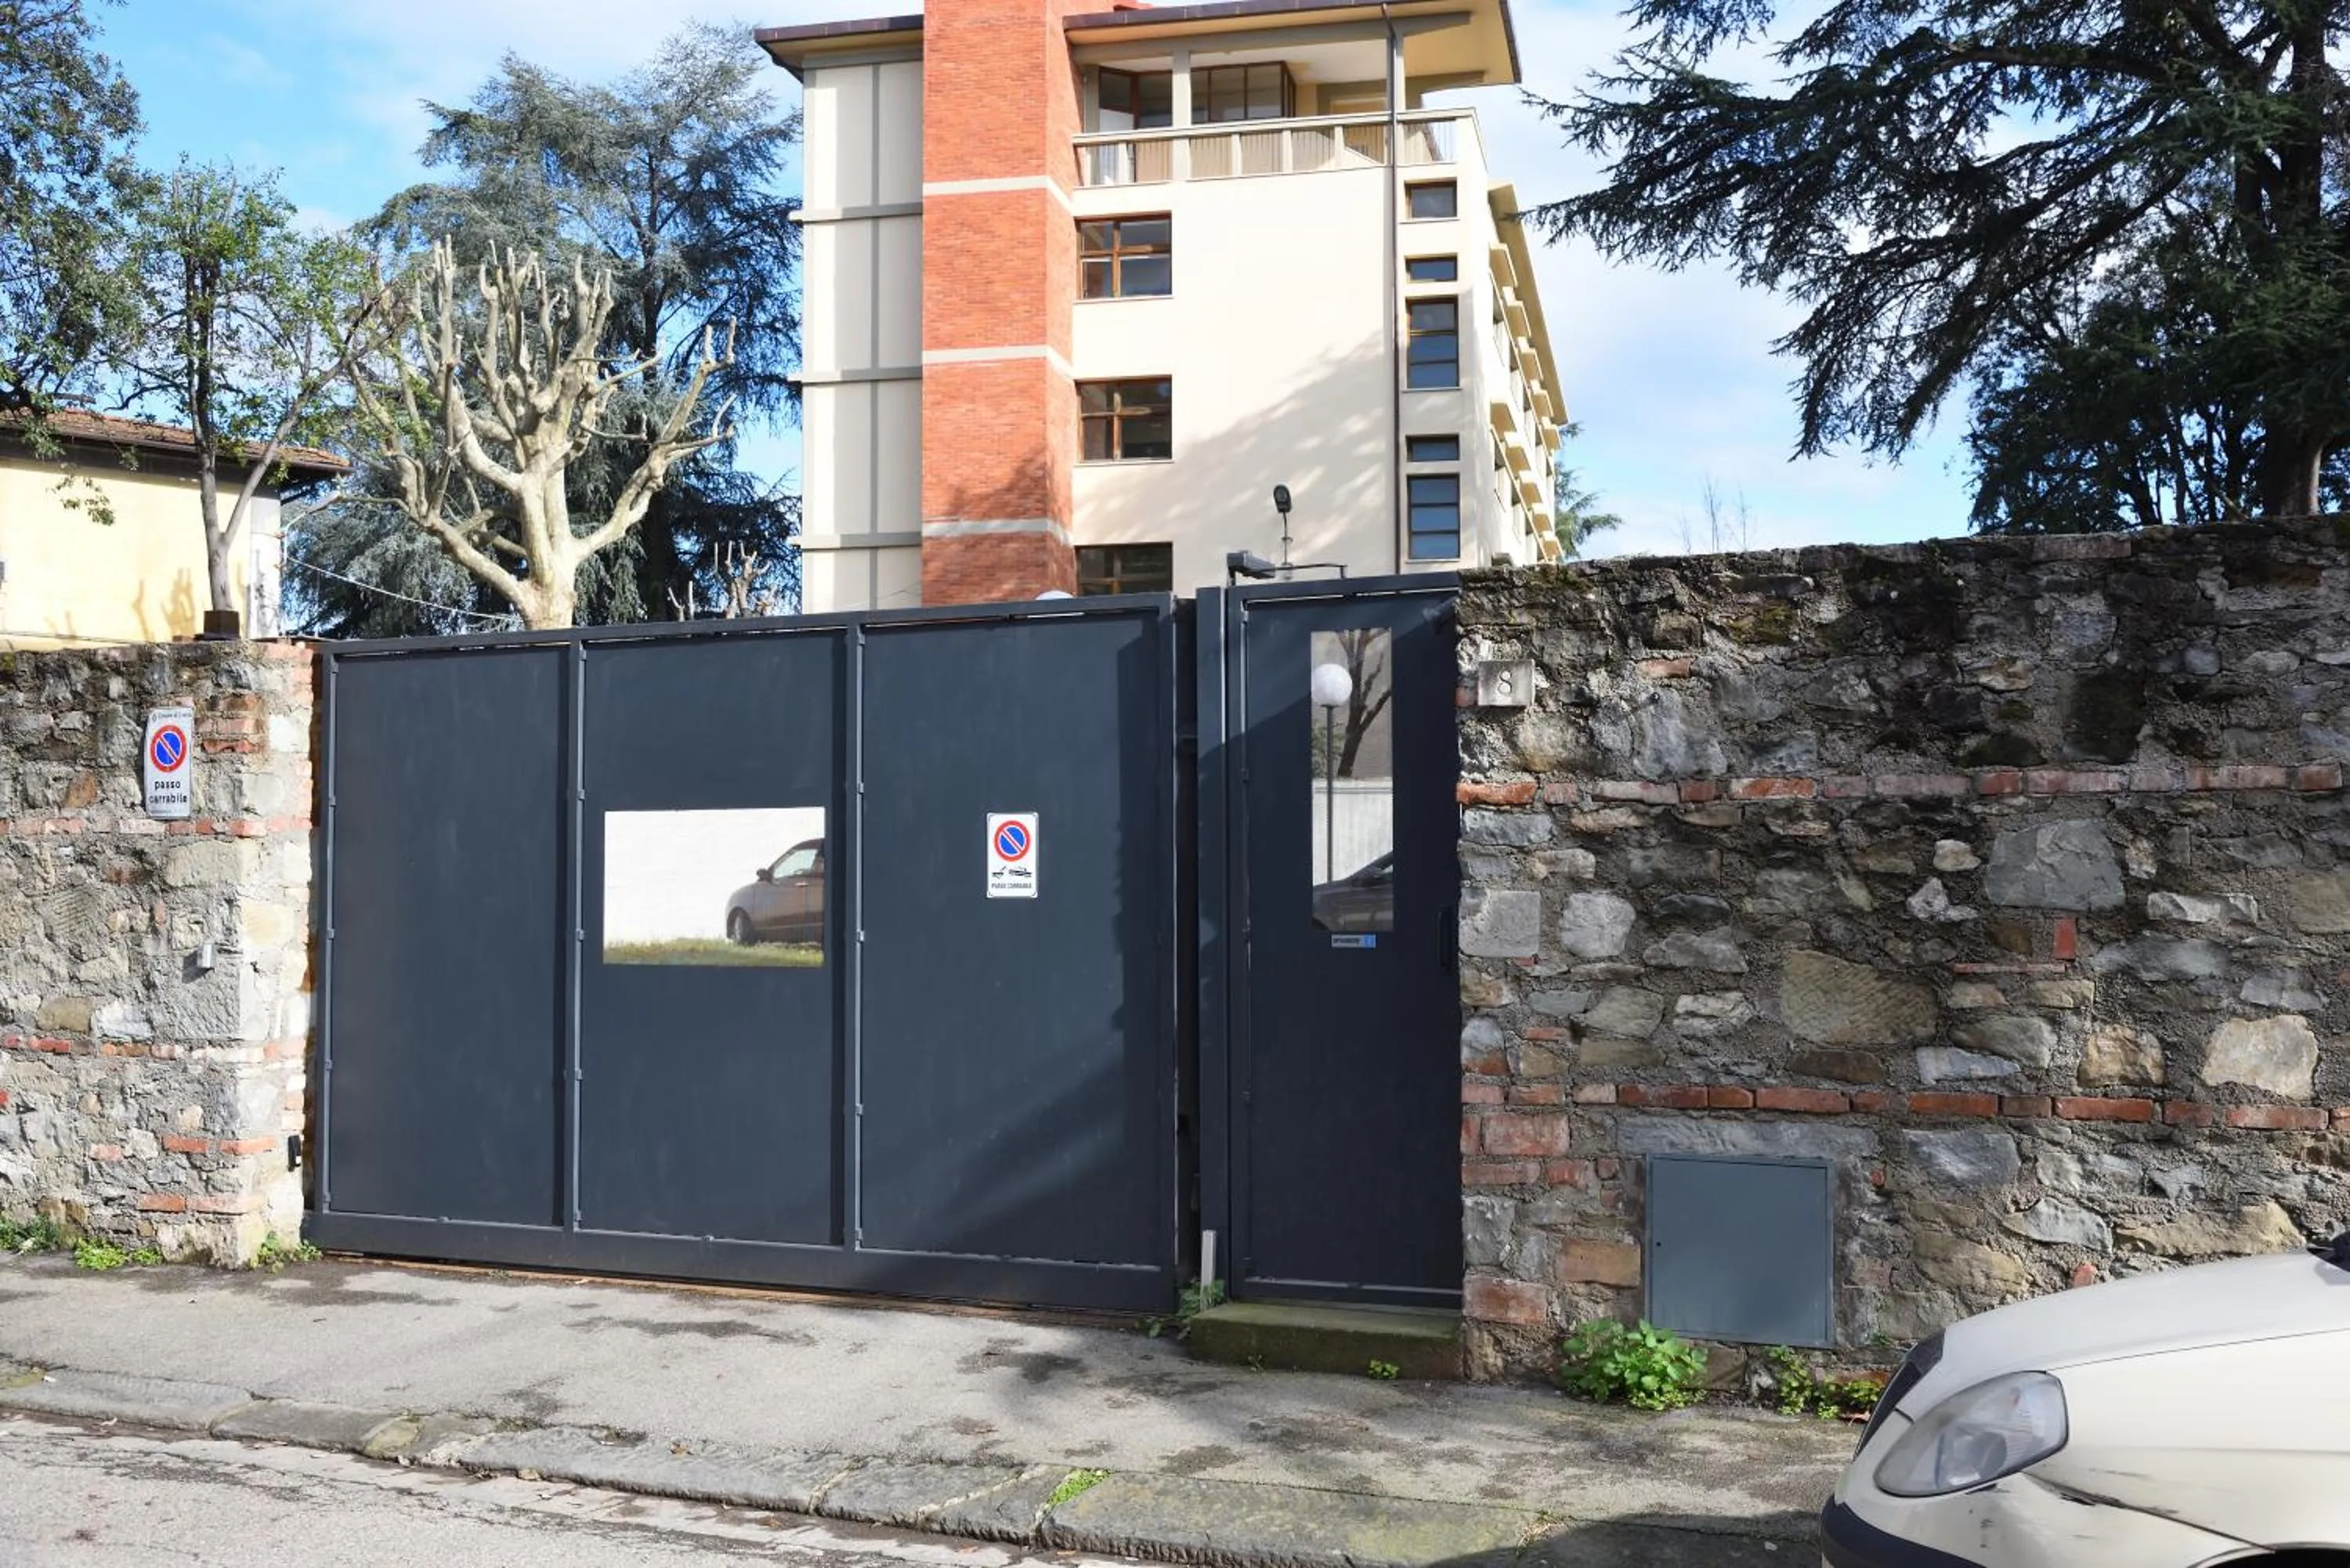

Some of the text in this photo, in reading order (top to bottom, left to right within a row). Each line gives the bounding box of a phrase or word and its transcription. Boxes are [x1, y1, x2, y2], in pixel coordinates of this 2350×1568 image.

[1497, 669, 1513, 695] 8
[154, 781, 181, 791] passo
[149, 793, 187, 804] carrabile
